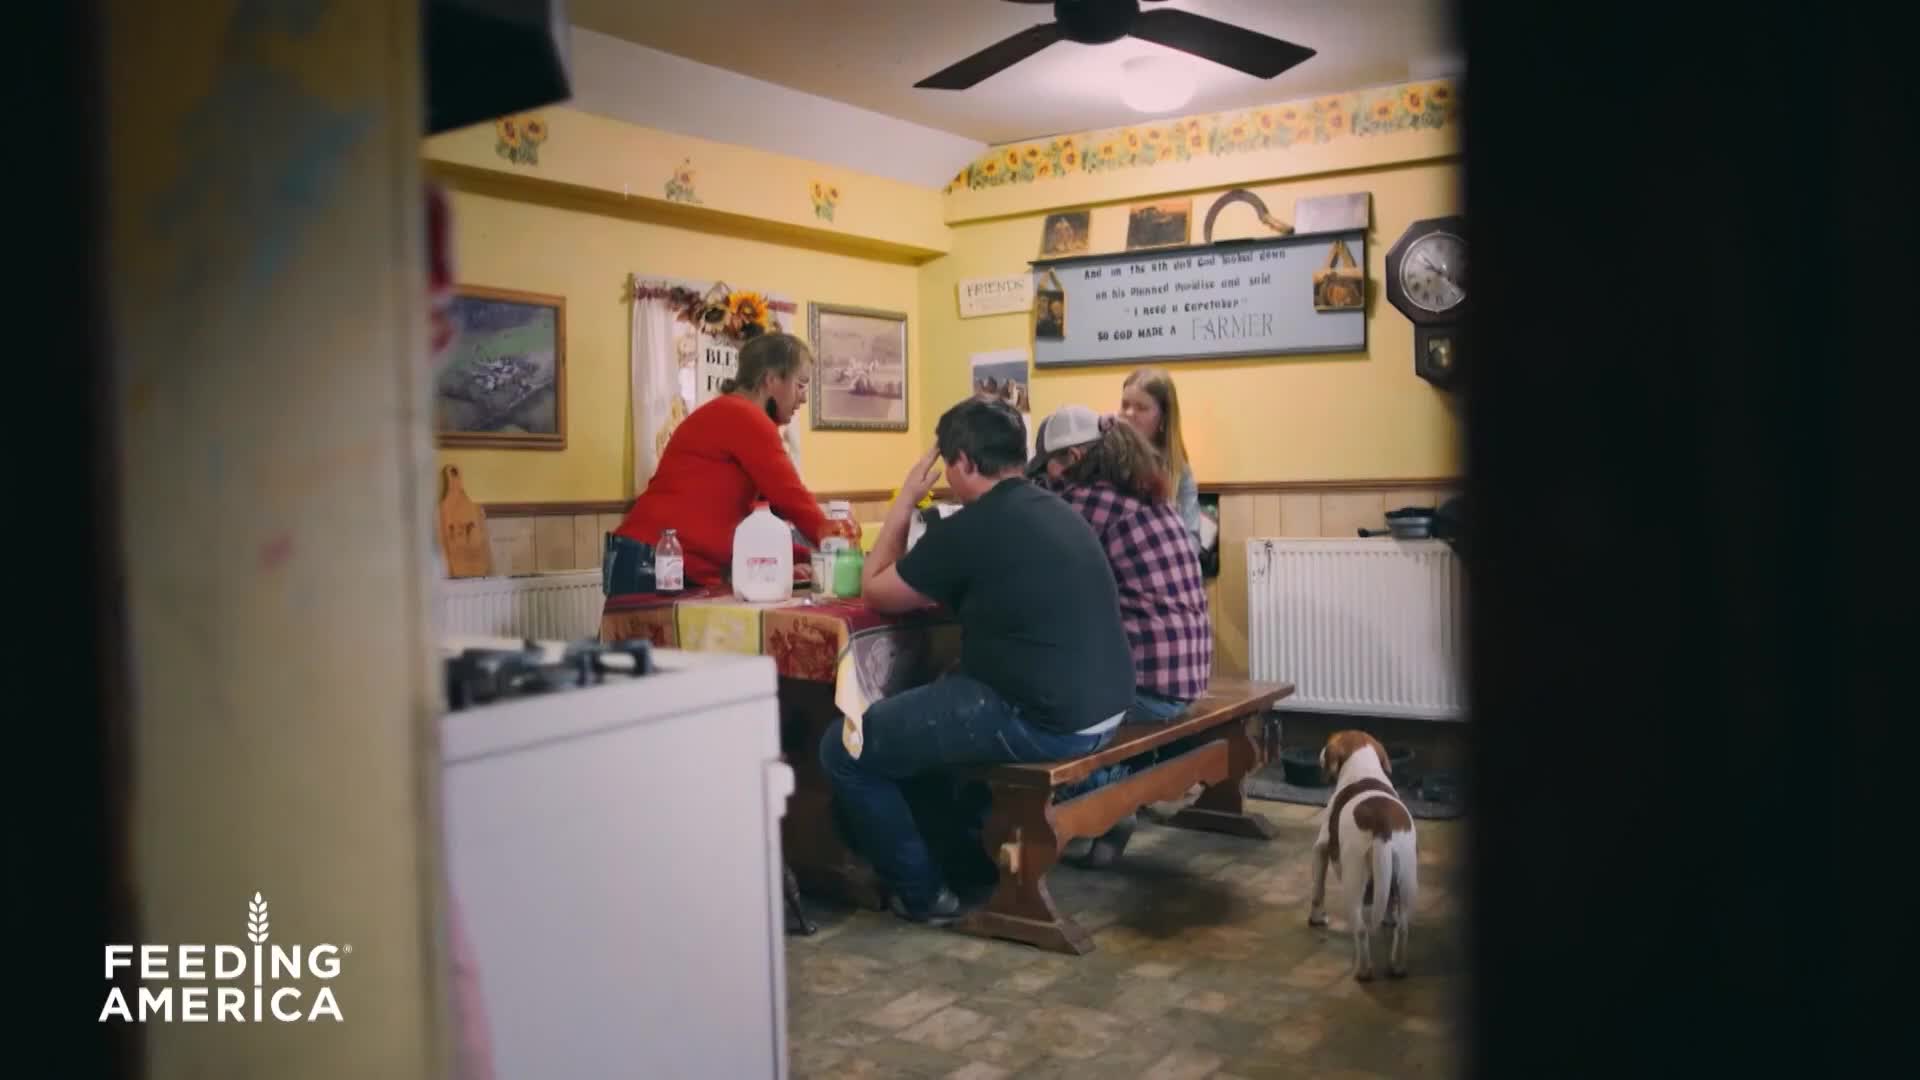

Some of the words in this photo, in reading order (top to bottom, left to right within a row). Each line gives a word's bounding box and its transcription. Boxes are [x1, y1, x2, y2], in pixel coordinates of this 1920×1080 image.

[1085, 267, 1102, 280] And
[1131, 263, 1144, 274] the
[1260, 250, 1286, 261] down
[1112, 287, 1126, 299] his
[1221, 277, 1240, 288] and
[1249, 273, 1271, 286] said
[1144, 304, 1166, 316] need
[1097, 331, 1109, 341] SO
[1114, 329, 1132, 340] GOD
[1138, 326, 1163, 338] MADE
[1170, 325, 1176, 336] A
[1192, 312, 1272, 340] FARMER
